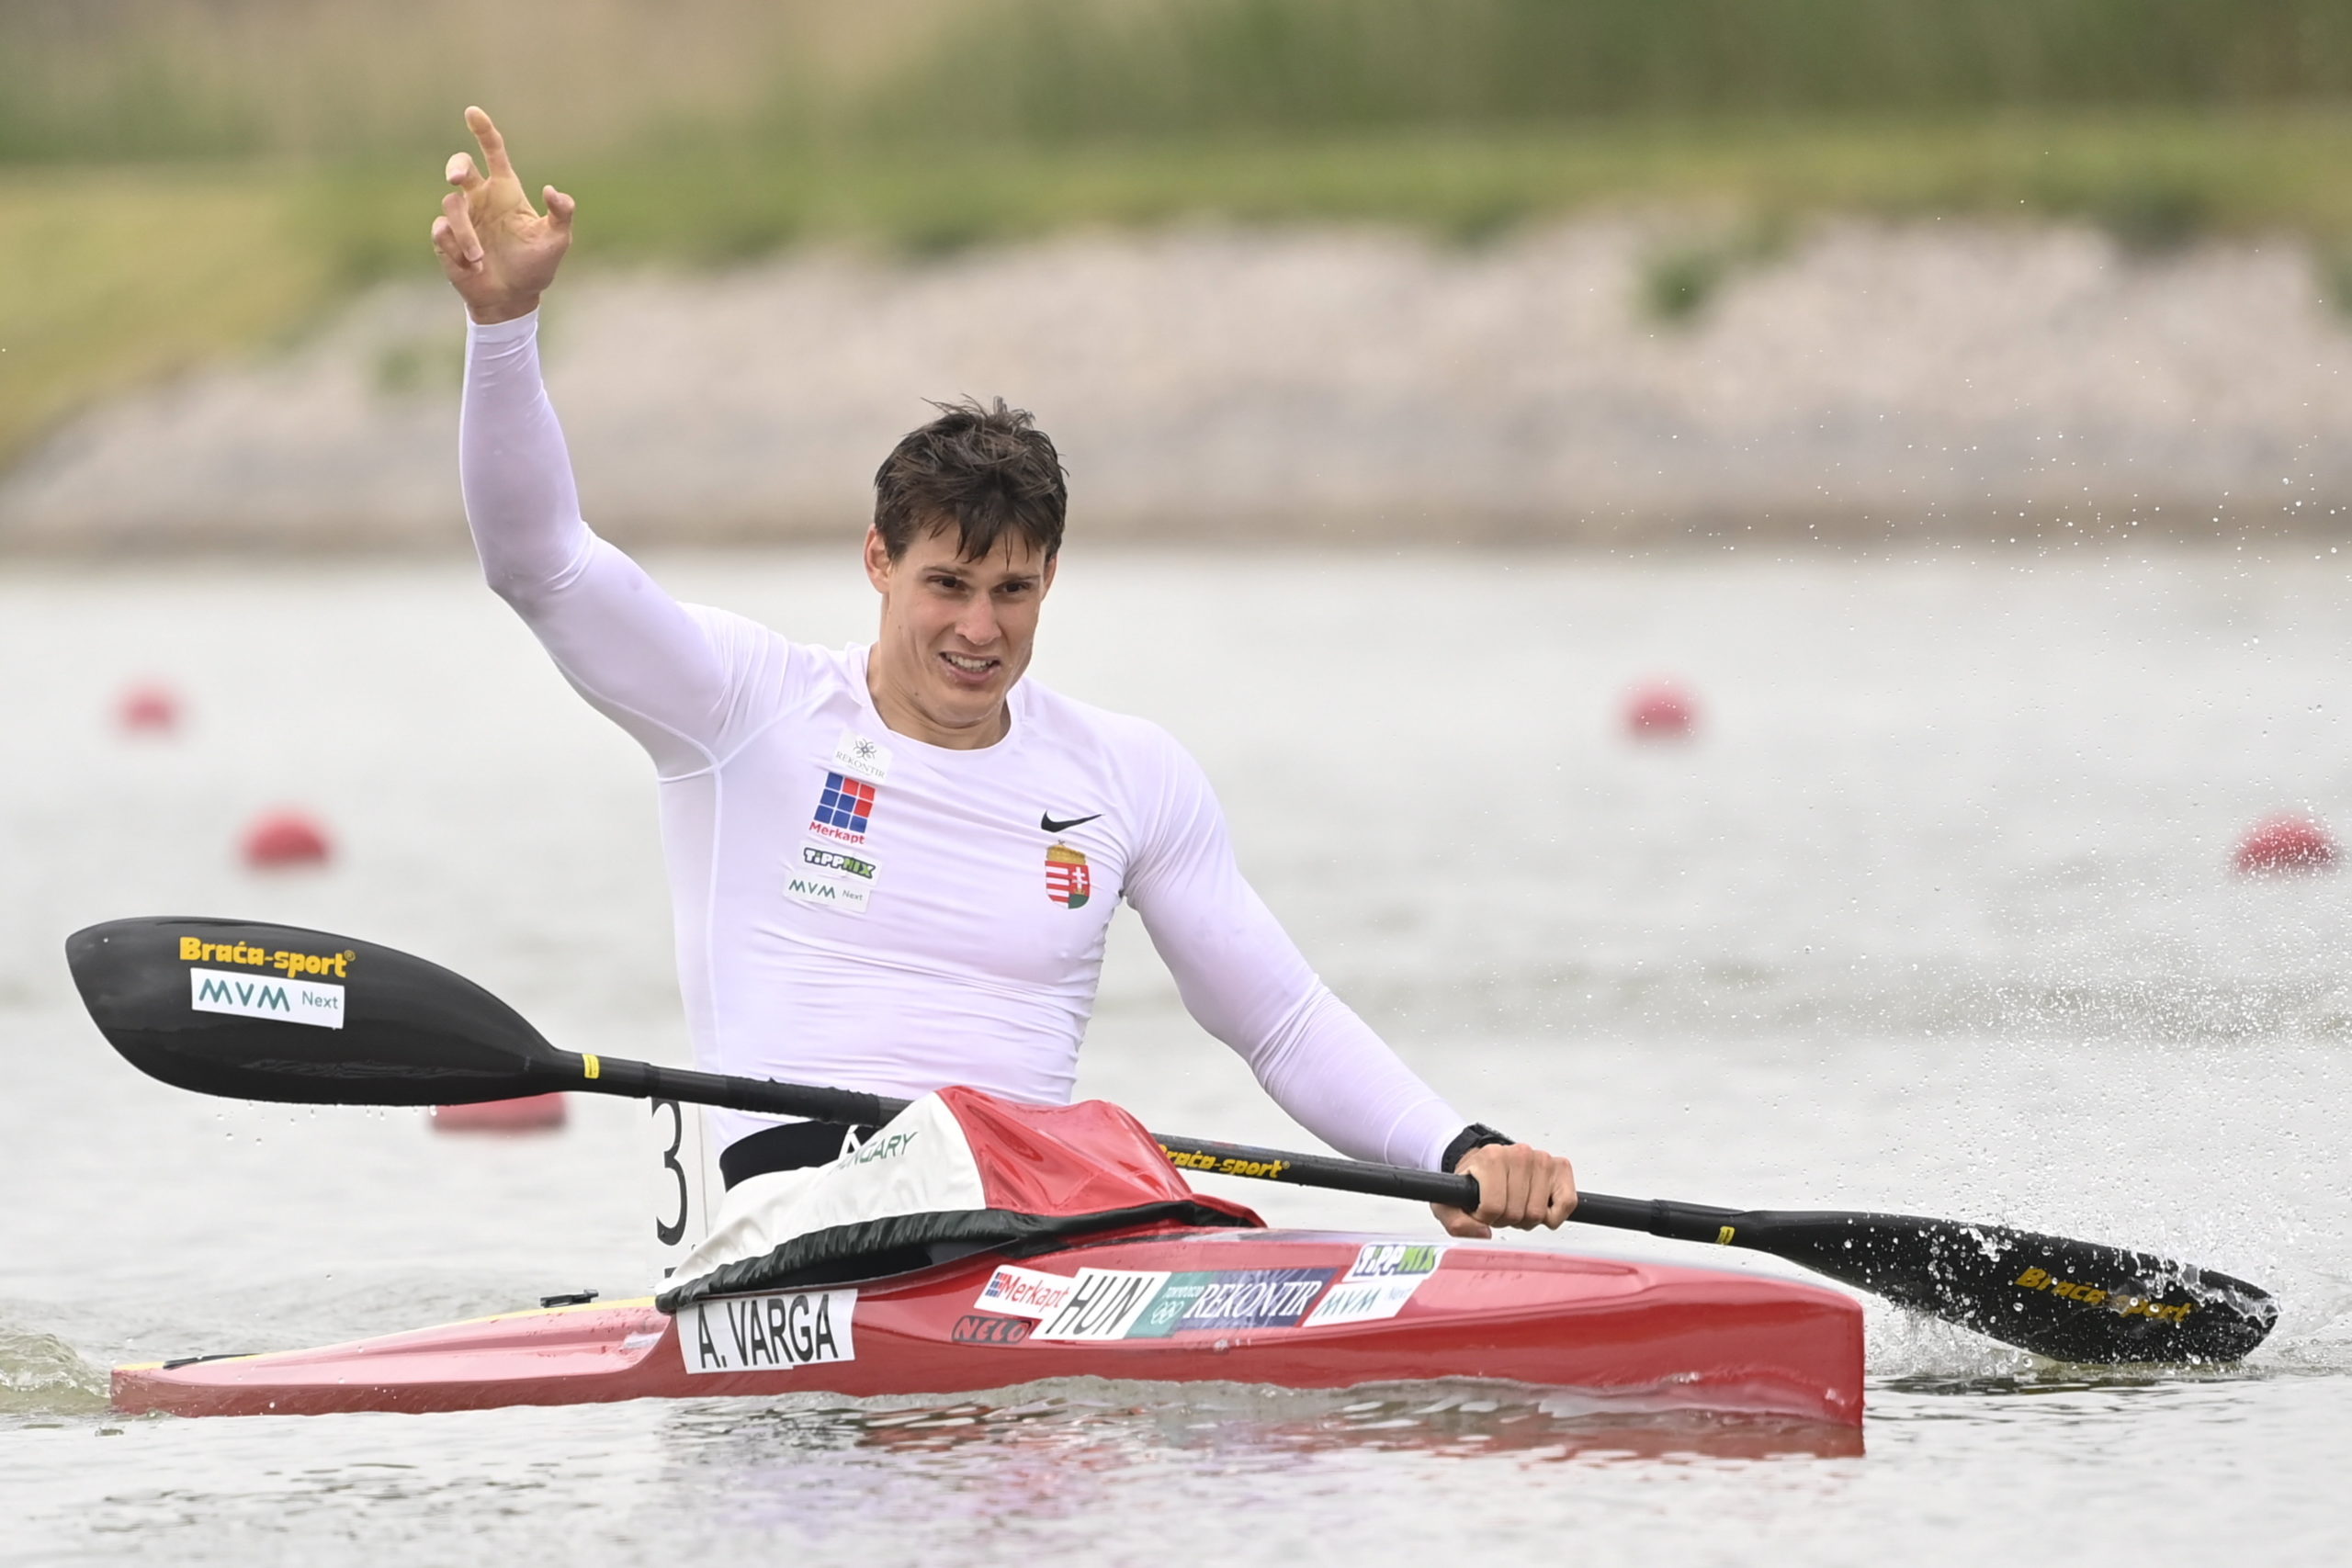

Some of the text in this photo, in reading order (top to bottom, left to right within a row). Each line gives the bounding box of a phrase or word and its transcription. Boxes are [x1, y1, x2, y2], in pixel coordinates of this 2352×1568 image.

[835, 750, 886, 779] REKONTIR
[808, 821, 865, 844] Merkapt
[788, 879, 864, 901] MVM Next
[198, 977, 339, 1012] MVM Next
[650, 1096, 688, 1246] 3
[998, 1276, 1071, 1313] Merkapt
[1045, 1274, 1155, 1336] HUN
[1182, 1281, 1323, 1319] REKONTIR
[1312, 1287, 1382, 1318] MVM
[697, 1293, 839, 1370] A. VARGA
